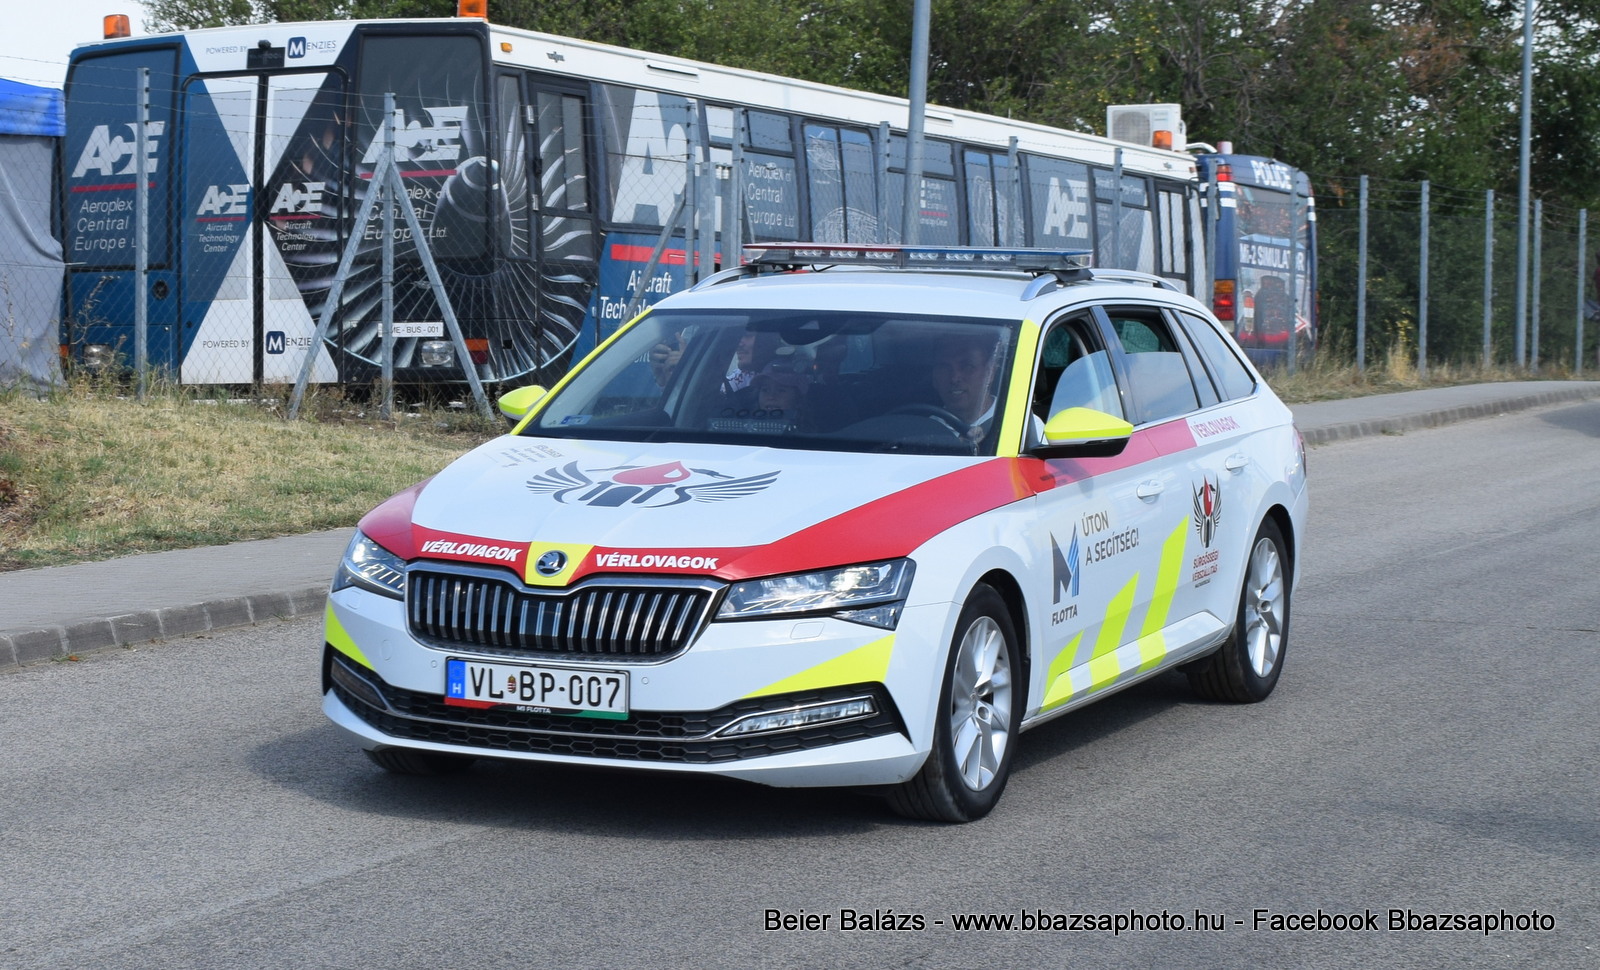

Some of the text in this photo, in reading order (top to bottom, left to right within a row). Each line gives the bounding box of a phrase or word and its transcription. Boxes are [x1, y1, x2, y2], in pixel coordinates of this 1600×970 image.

[206, 46, 237, 55] POWERED
[1250, 160, 1292, 190] POLICE
[748, 183, 783, 203] Central
[80, 197, 133, 215] Aeroplex
[77, 216, 129, 233] Central
[206, 223, 233, 232] Aircraft
[284, 221, 312, 230] Aircraft
[74, 236, 126, 253] Europe
[199, 234, 239, 244] Technology
[281, 242, 306, 251] Center
[204, 244, 228, 253] Center
[406, 326, 422, 334] BUS
[427, 325, 438, 333] 001
[203, 339, 250, 349] POWERED BY
[1081, 510, 1109, 537] ÚTON
[421, 541, 521, 562] VÉRLOVAGOK
[1085, 525, 1140, 566] A SEGÍTSÉG!
[596, 552, 718, 570] VÉRLOVAGOK
[1051, 604, 1078, 627] FLOTTA
[453, 683, 462, 695] H
[470, 667, 504, 699] VL
[526, 703, 551, 714] FLOTTA
